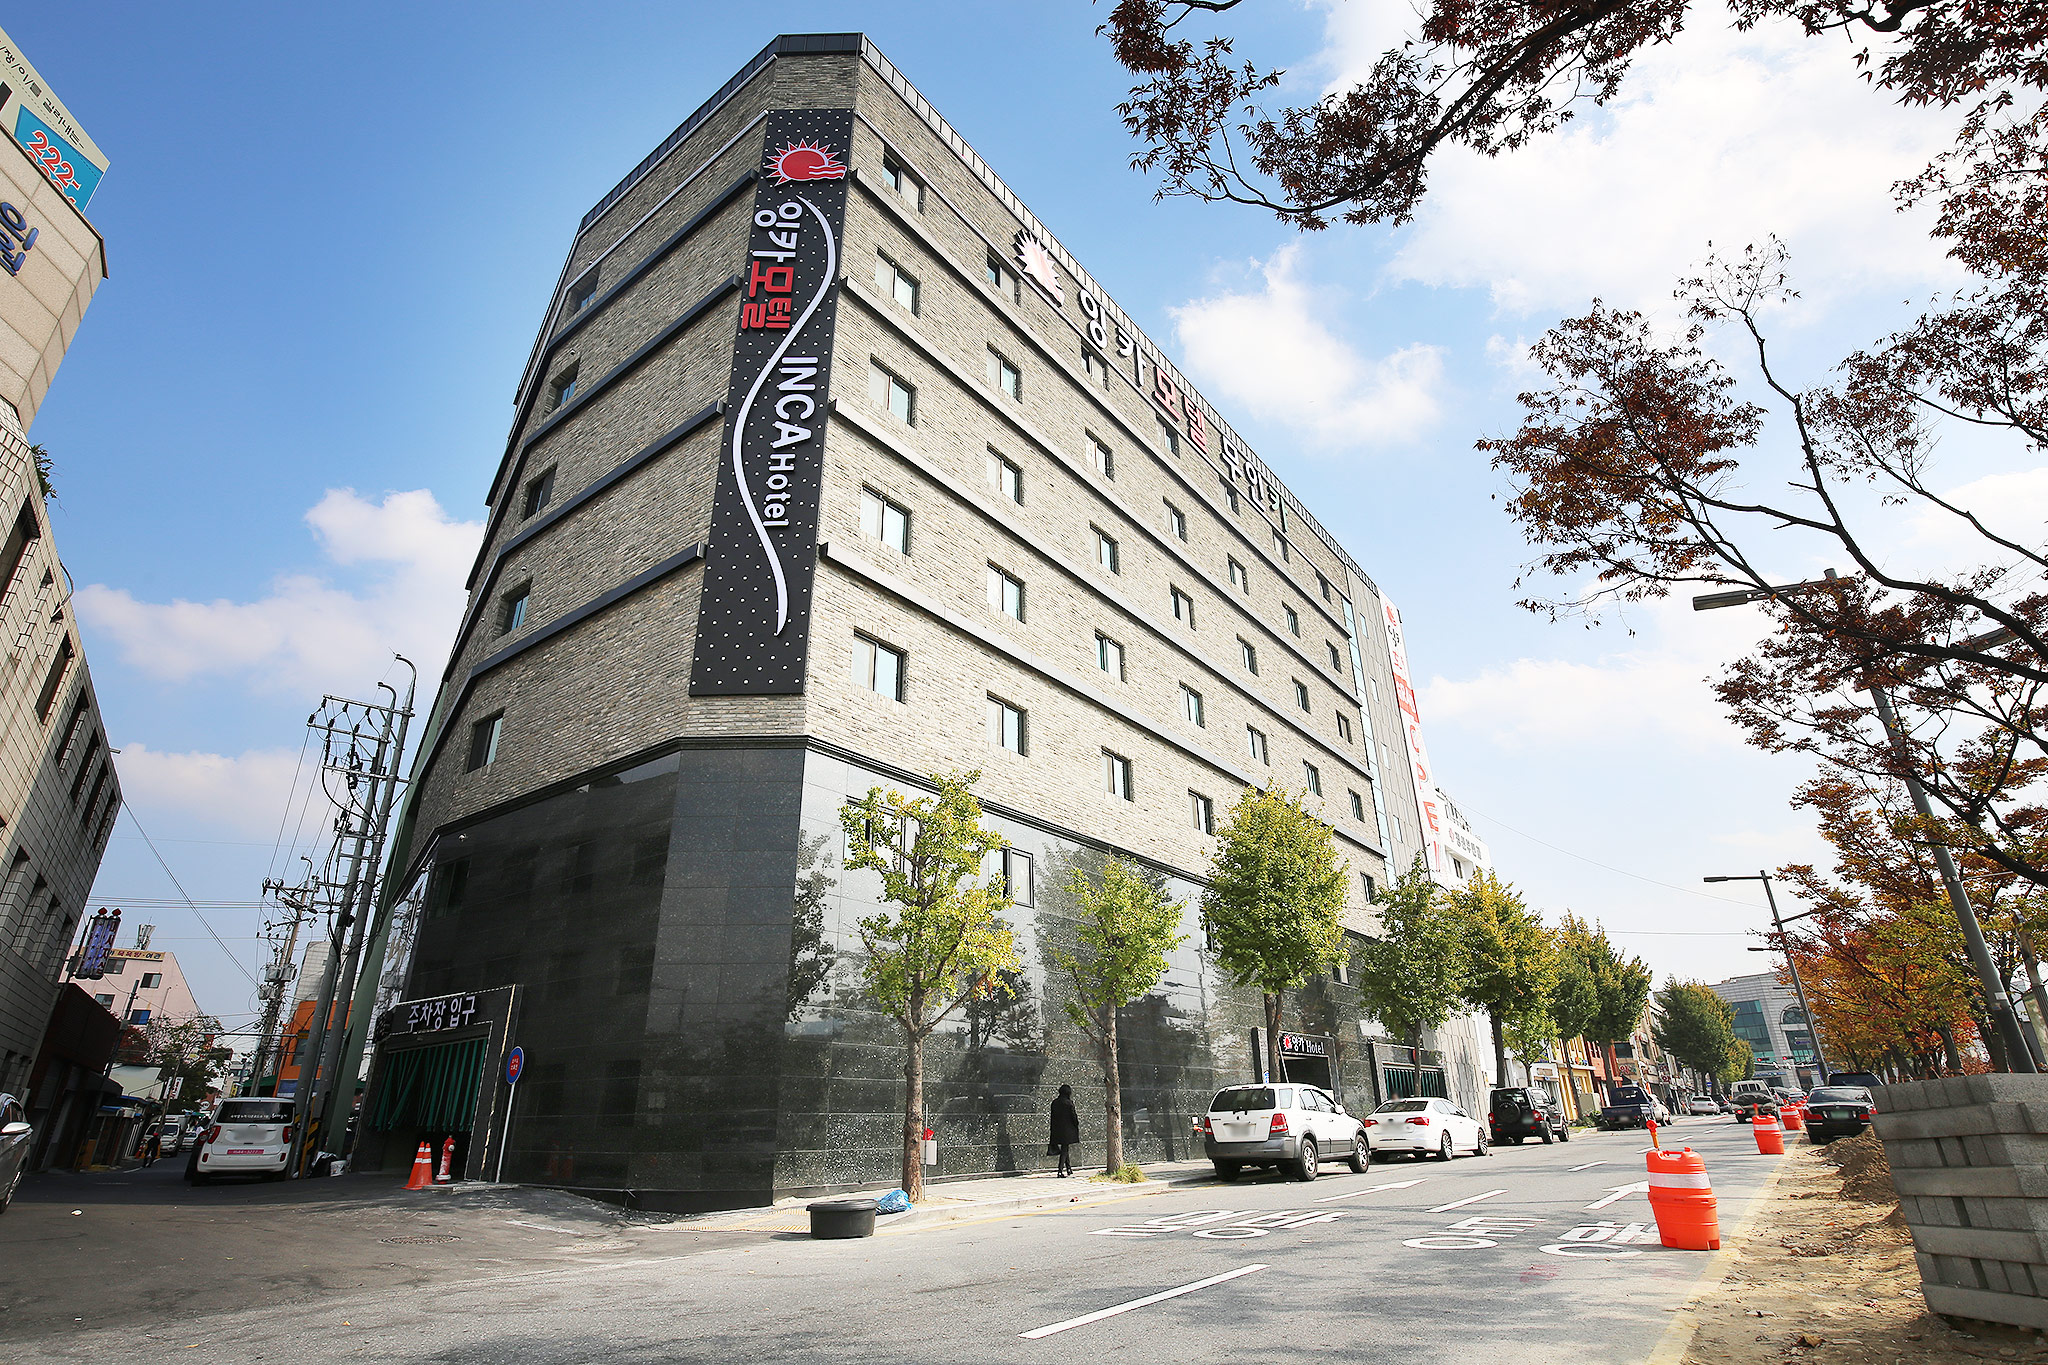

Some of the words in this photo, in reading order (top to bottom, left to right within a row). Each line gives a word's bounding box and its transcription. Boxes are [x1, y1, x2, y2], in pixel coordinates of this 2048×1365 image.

[772, 356, 819, 449] INCA
[407, 1001, 447, 1032] 주차장
[450, 996, 476, 1026] 입구
[1305, 1039, 1325, 1054] Hotel
